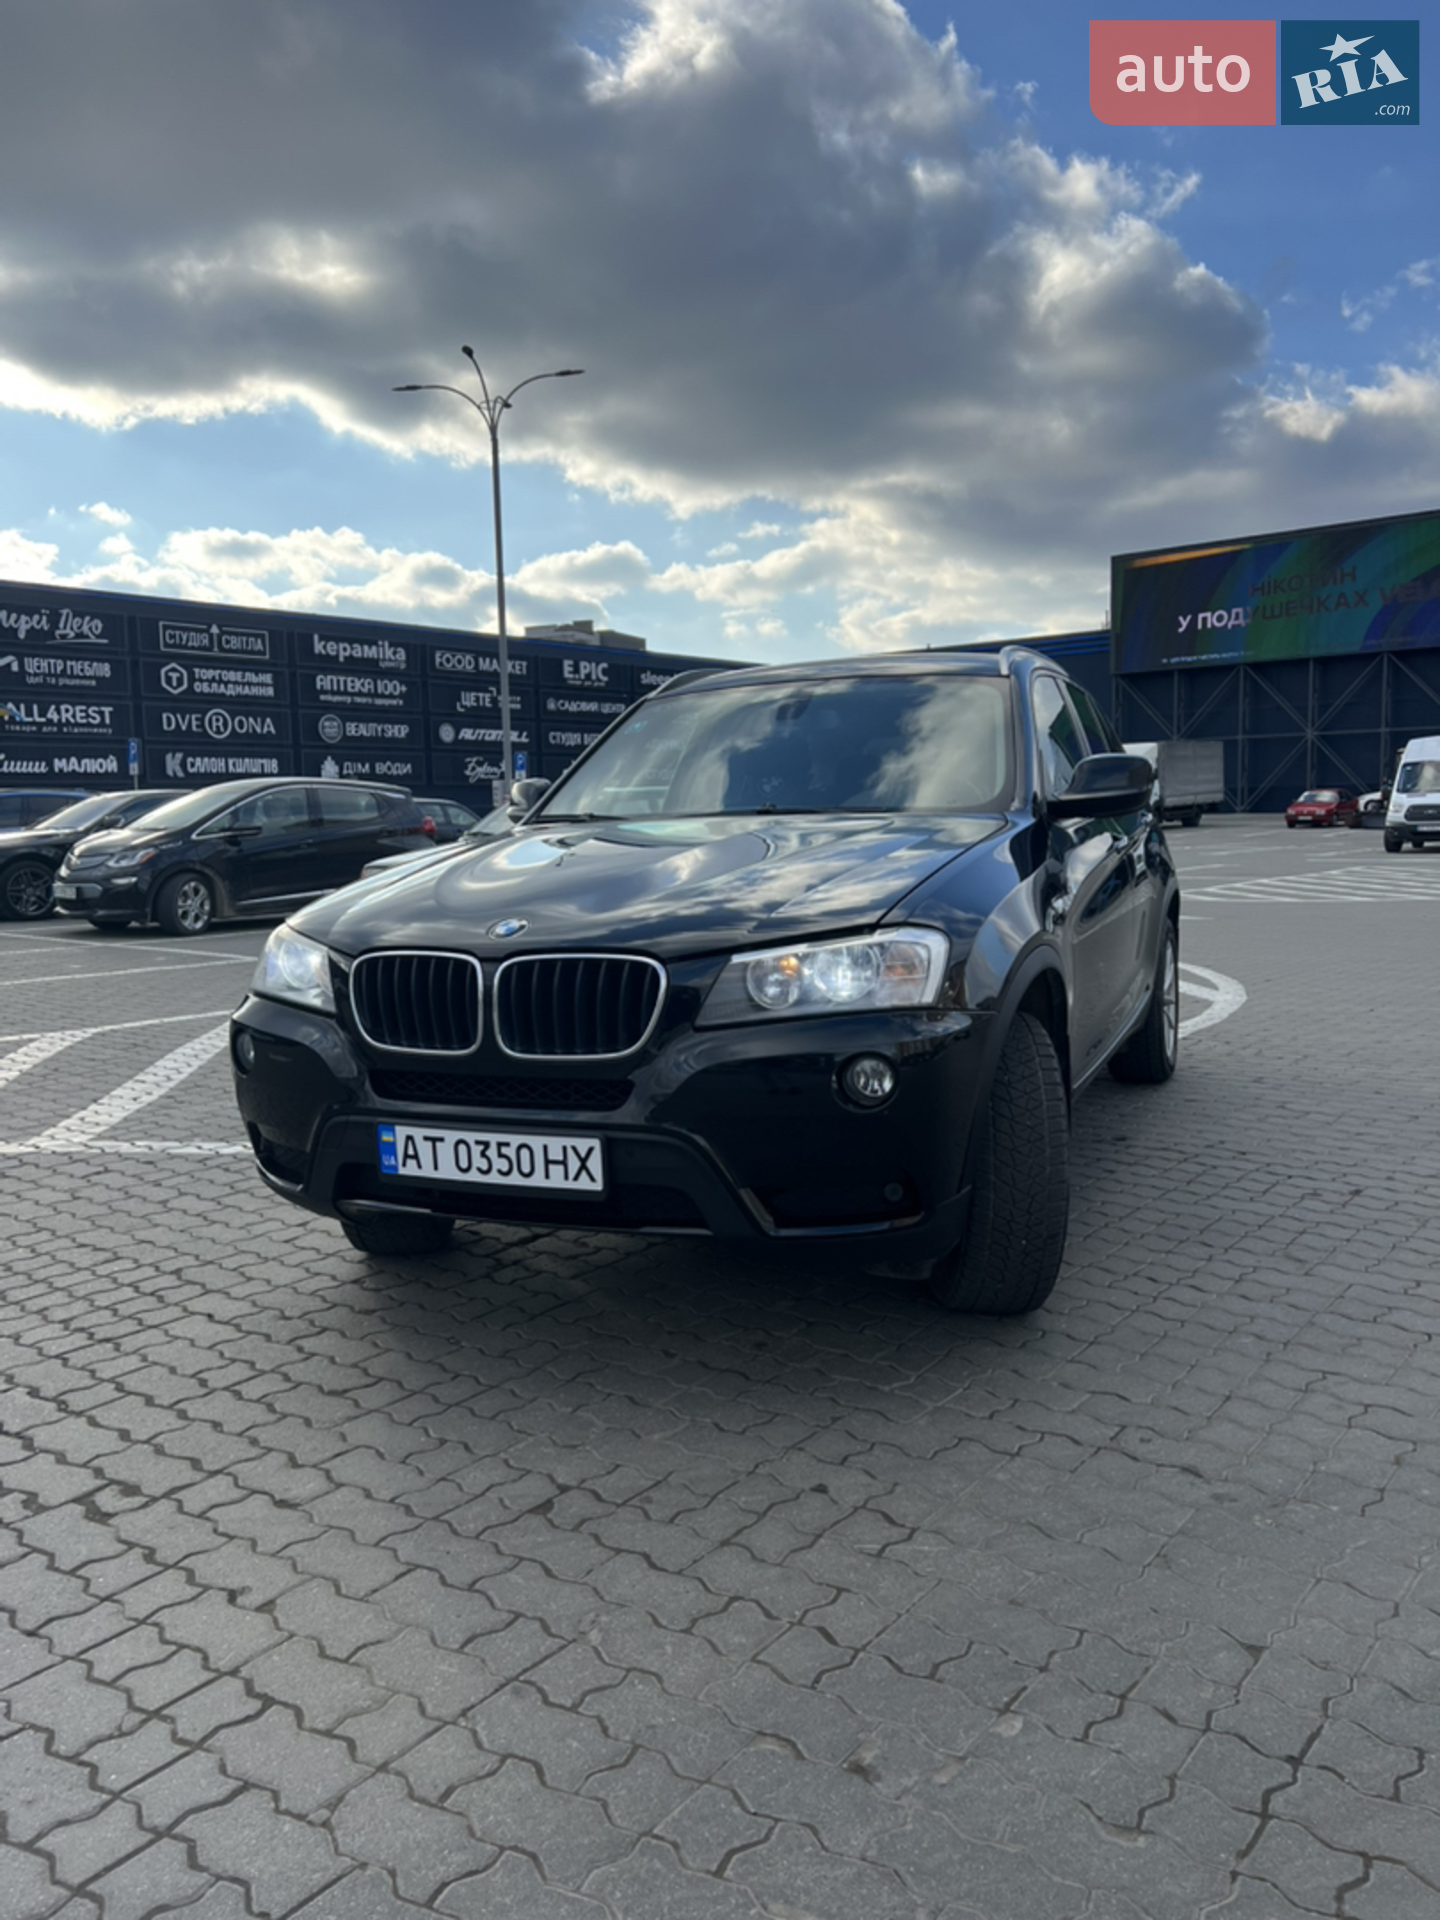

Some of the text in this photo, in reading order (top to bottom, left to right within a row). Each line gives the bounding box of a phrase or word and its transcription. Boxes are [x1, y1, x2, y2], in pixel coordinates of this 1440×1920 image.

[1197, 590, 1370, 631] ПОДУШЕЧКАХ
[164, 630, 265, 652] СТУДІЯ СВІТЛА
[24, 657, 111, 678] ЦЕНТР МЕБЛІВ
[434, 651, 528, 675] FOOD MAKET
[562, 659, 610, 682] E.PIC
[192, 668, 274, 685] ТОРГОВЕЛЬНЕ
[315, 674, 408, 696] АПТЕКА 100+
[193, 681, 275, 697] ОБЛАДНАННЯ
[161, 708, 276, 739] DVERONA
[345, 721, 382, 737] BEAUTY
[383, 723, 410, 738] SHOP
[53, 755, 118, 774] МАЛЮЙ
[186, 757, 279, 774] САЛОН КИЛИМІВ
[342, 761, 412, 776] ДІМ ВОДИ
[401, 1133, 597, 1183] AT 0350 HX
